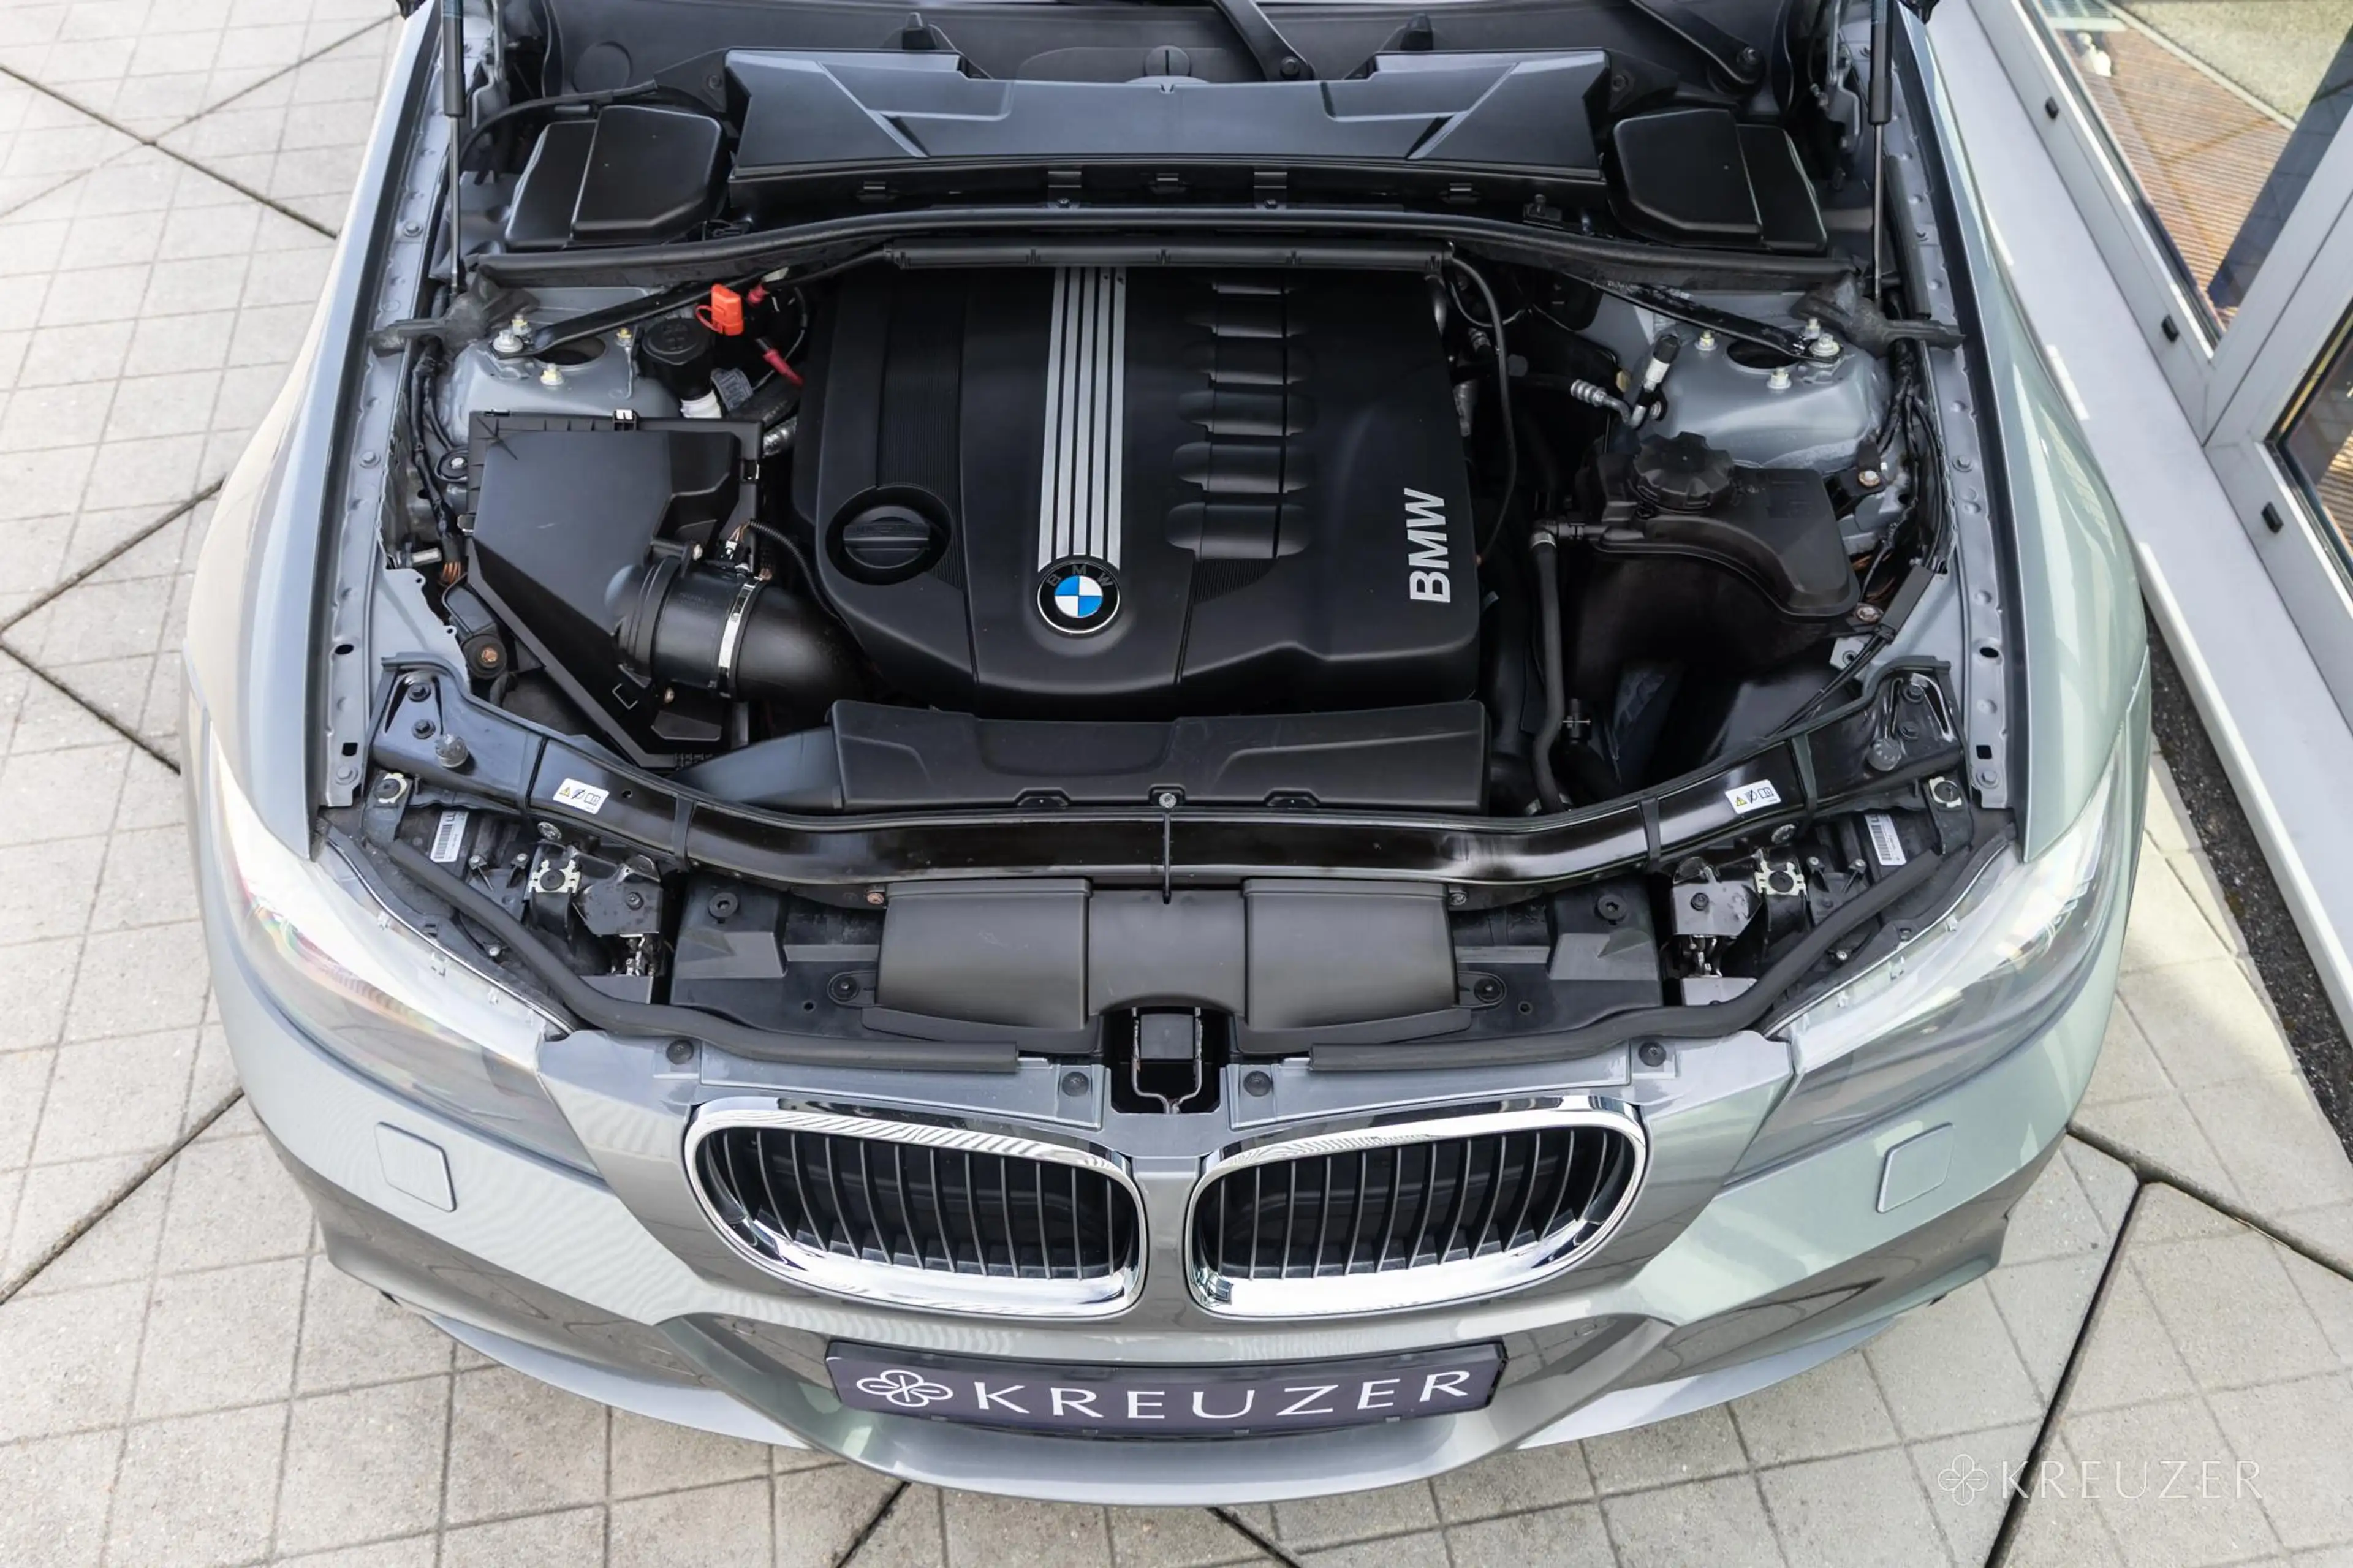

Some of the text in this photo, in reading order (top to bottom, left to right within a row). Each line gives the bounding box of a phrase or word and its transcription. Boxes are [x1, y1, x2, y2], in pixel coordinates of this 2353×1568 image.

[1404, 488, 1450, 602] BMW
[1046, 564, 1113, 587] BMW
[974, 1371, 1470, 1420] KREUZER
